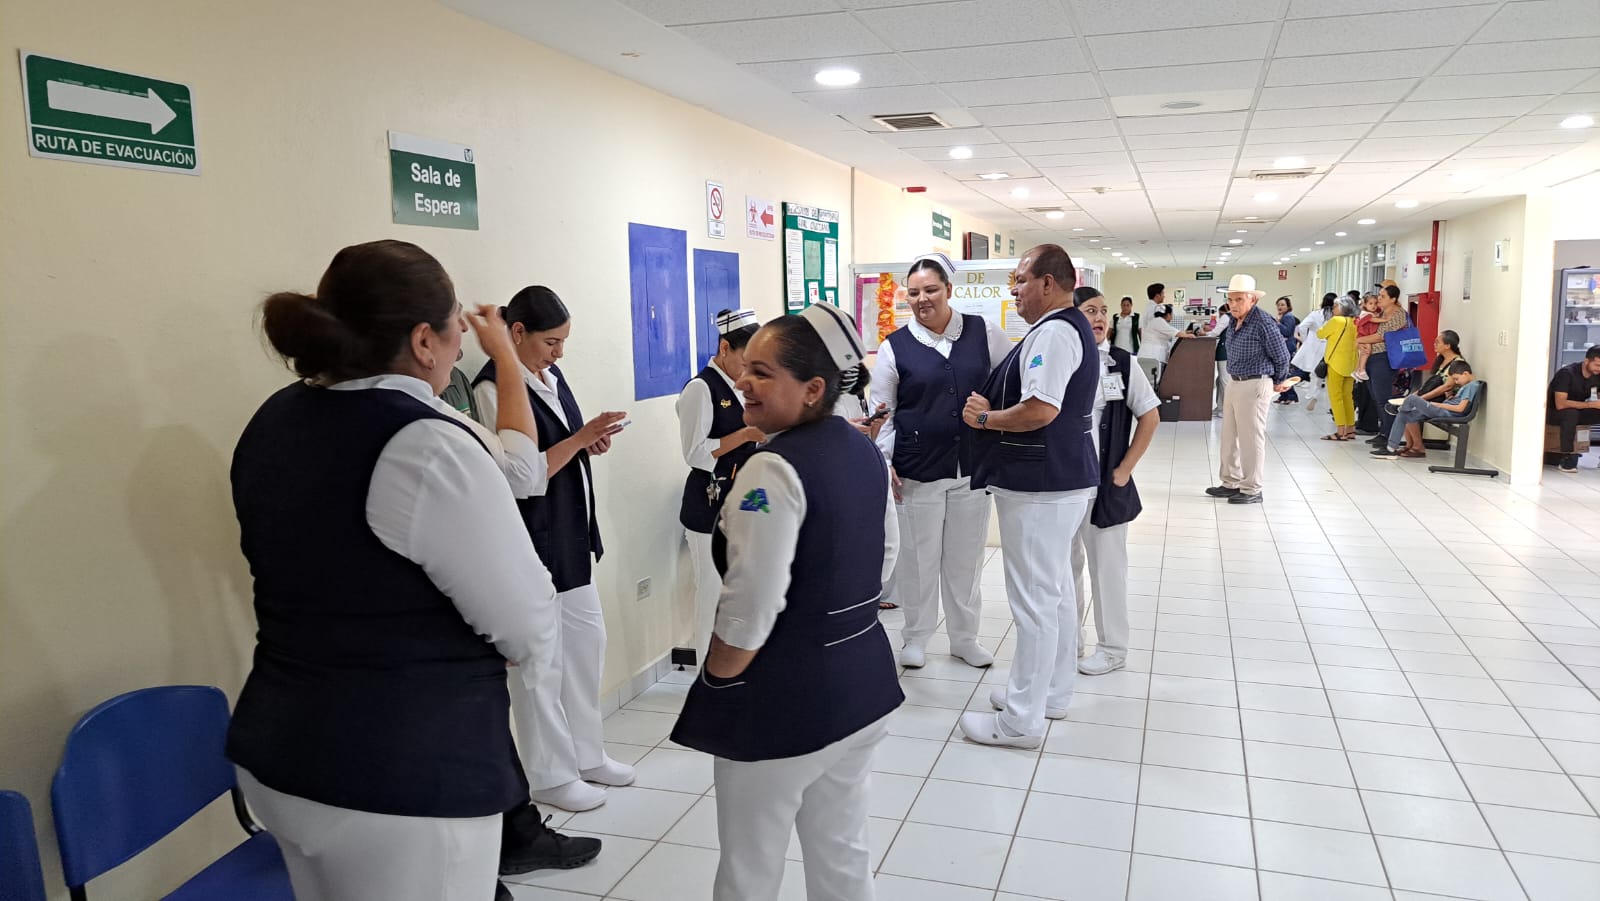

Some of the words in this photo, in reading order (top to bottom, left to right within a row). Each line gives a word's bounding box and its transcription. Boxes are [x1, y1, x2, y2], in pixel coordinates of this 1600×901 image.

[34, 133, 79, 152] RUTA
[81, 139, 103, 155] DE
[105, 143, 194, 166] EVACUACIÓN
[411, 162, 441, 185] Sala
[444, 169, 461, 188] de
[414, 192, 461, 217] Espera
[967, 272, 985, 284] DE
[954, 286, 1002, 299] CALOR
